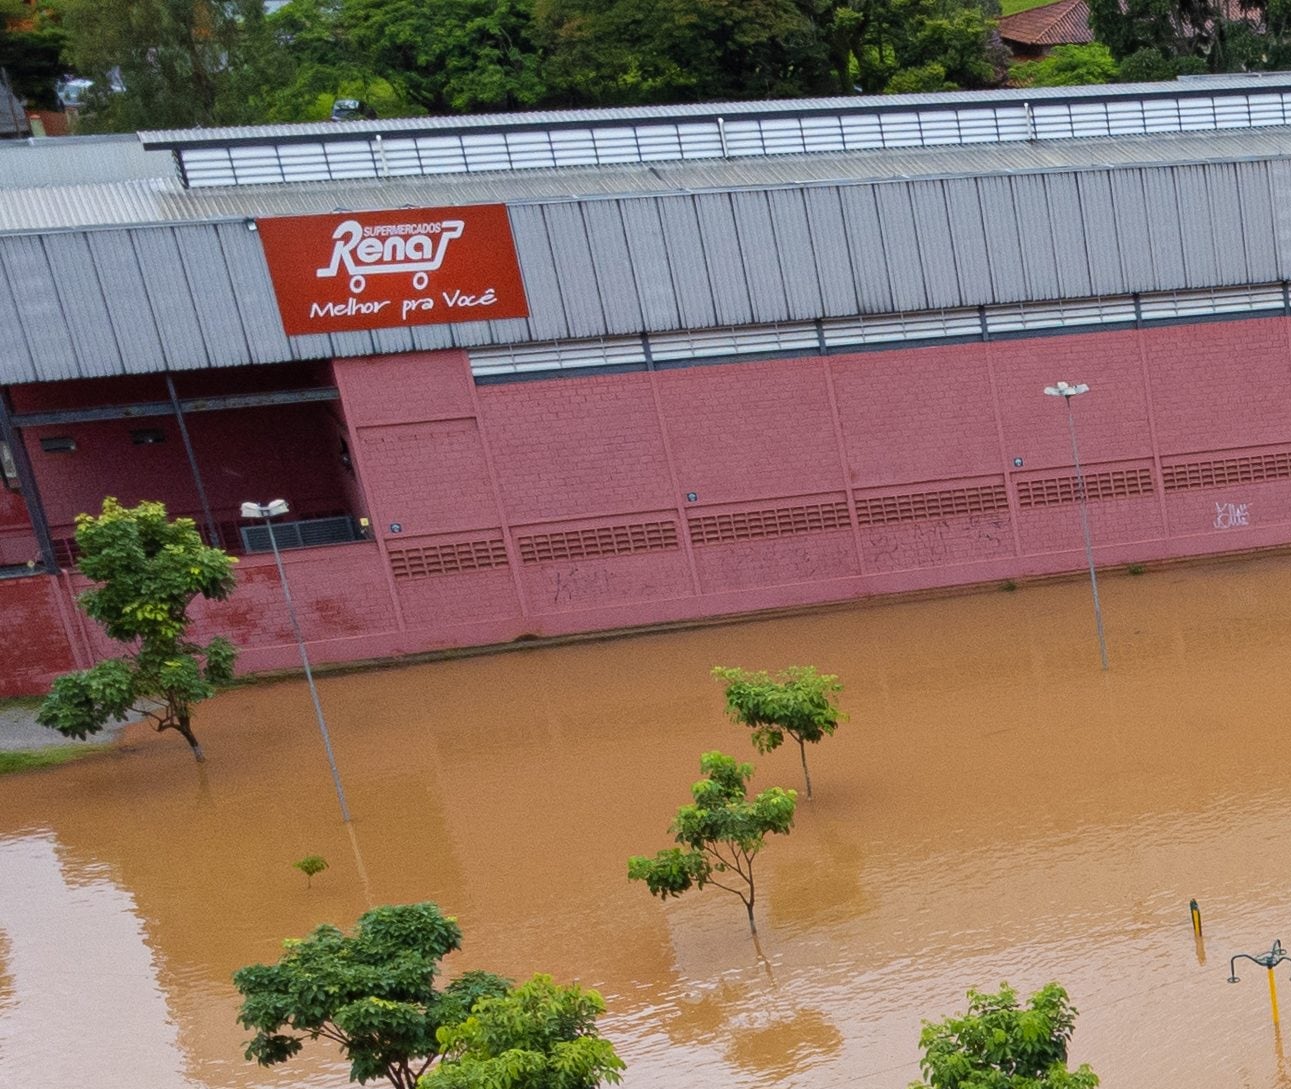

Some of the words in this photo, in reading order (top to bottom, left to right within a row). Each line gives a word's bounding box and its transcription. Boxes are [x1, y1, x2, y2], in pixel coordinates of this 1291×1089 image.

[363, 222, 441, 237] SUPERMERCADOS
[330, 219, 433, 275] Rena
[309, 297, 391, 319] Melhor
[402, 298, 434, 320] pra
[442, 288, 497, 308] Você
